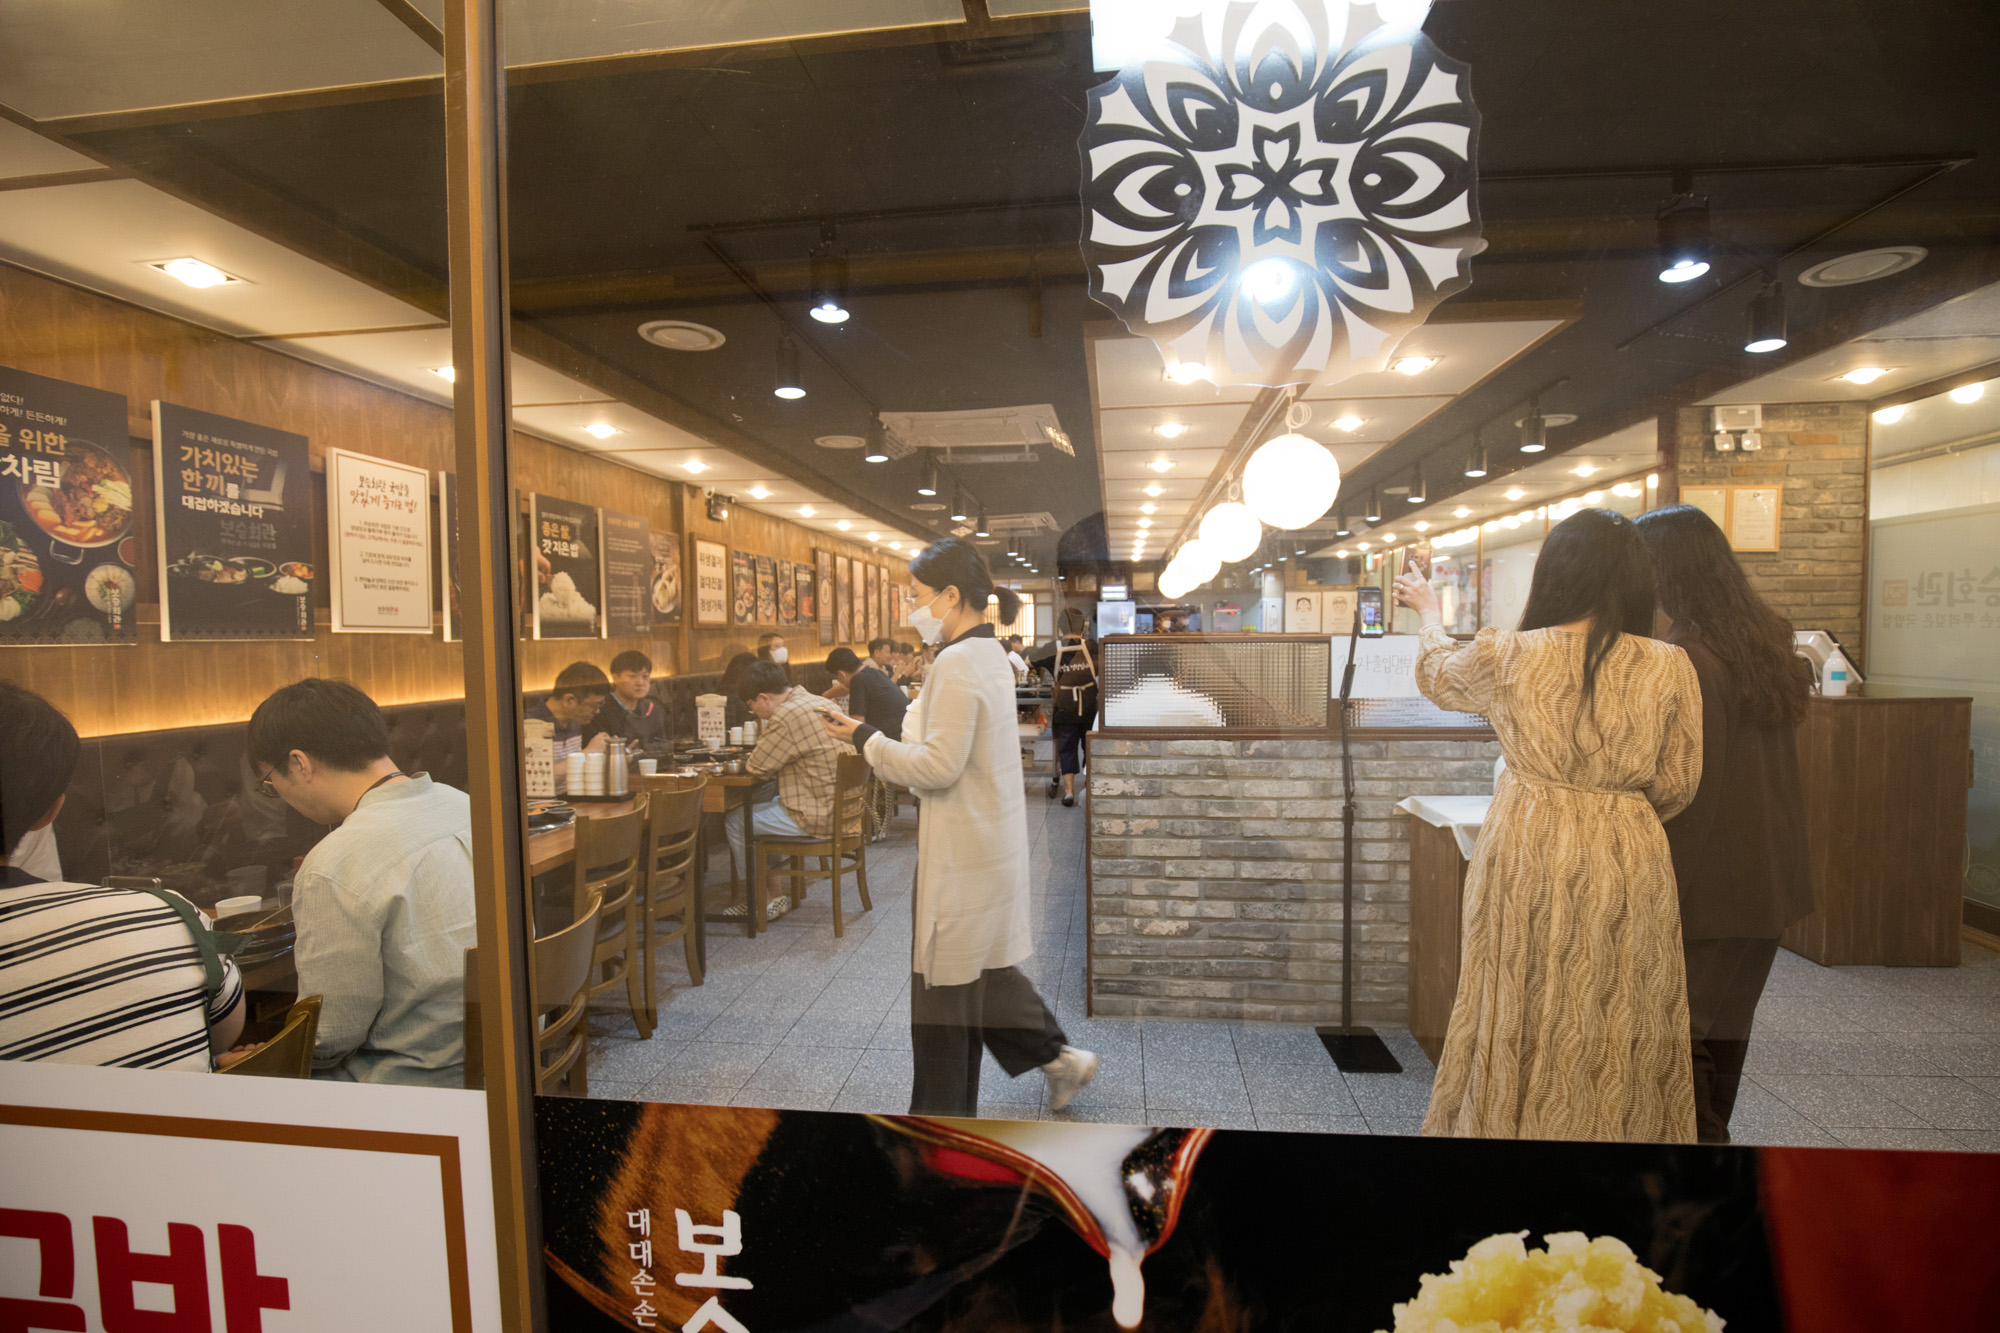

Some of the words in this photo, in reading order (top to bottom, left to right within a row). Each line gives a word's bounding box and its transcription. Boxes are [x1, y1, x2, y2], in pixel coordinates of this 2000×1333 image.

[26, 410, 67, 426] 든든하게!
[19, 428, 68, 456] 위한
[181, 445, 259, 479] 가치있는
[182, 495, 264, 519] 대접하겠습니다
[626, 1208, 658, 1327] 대대손손
